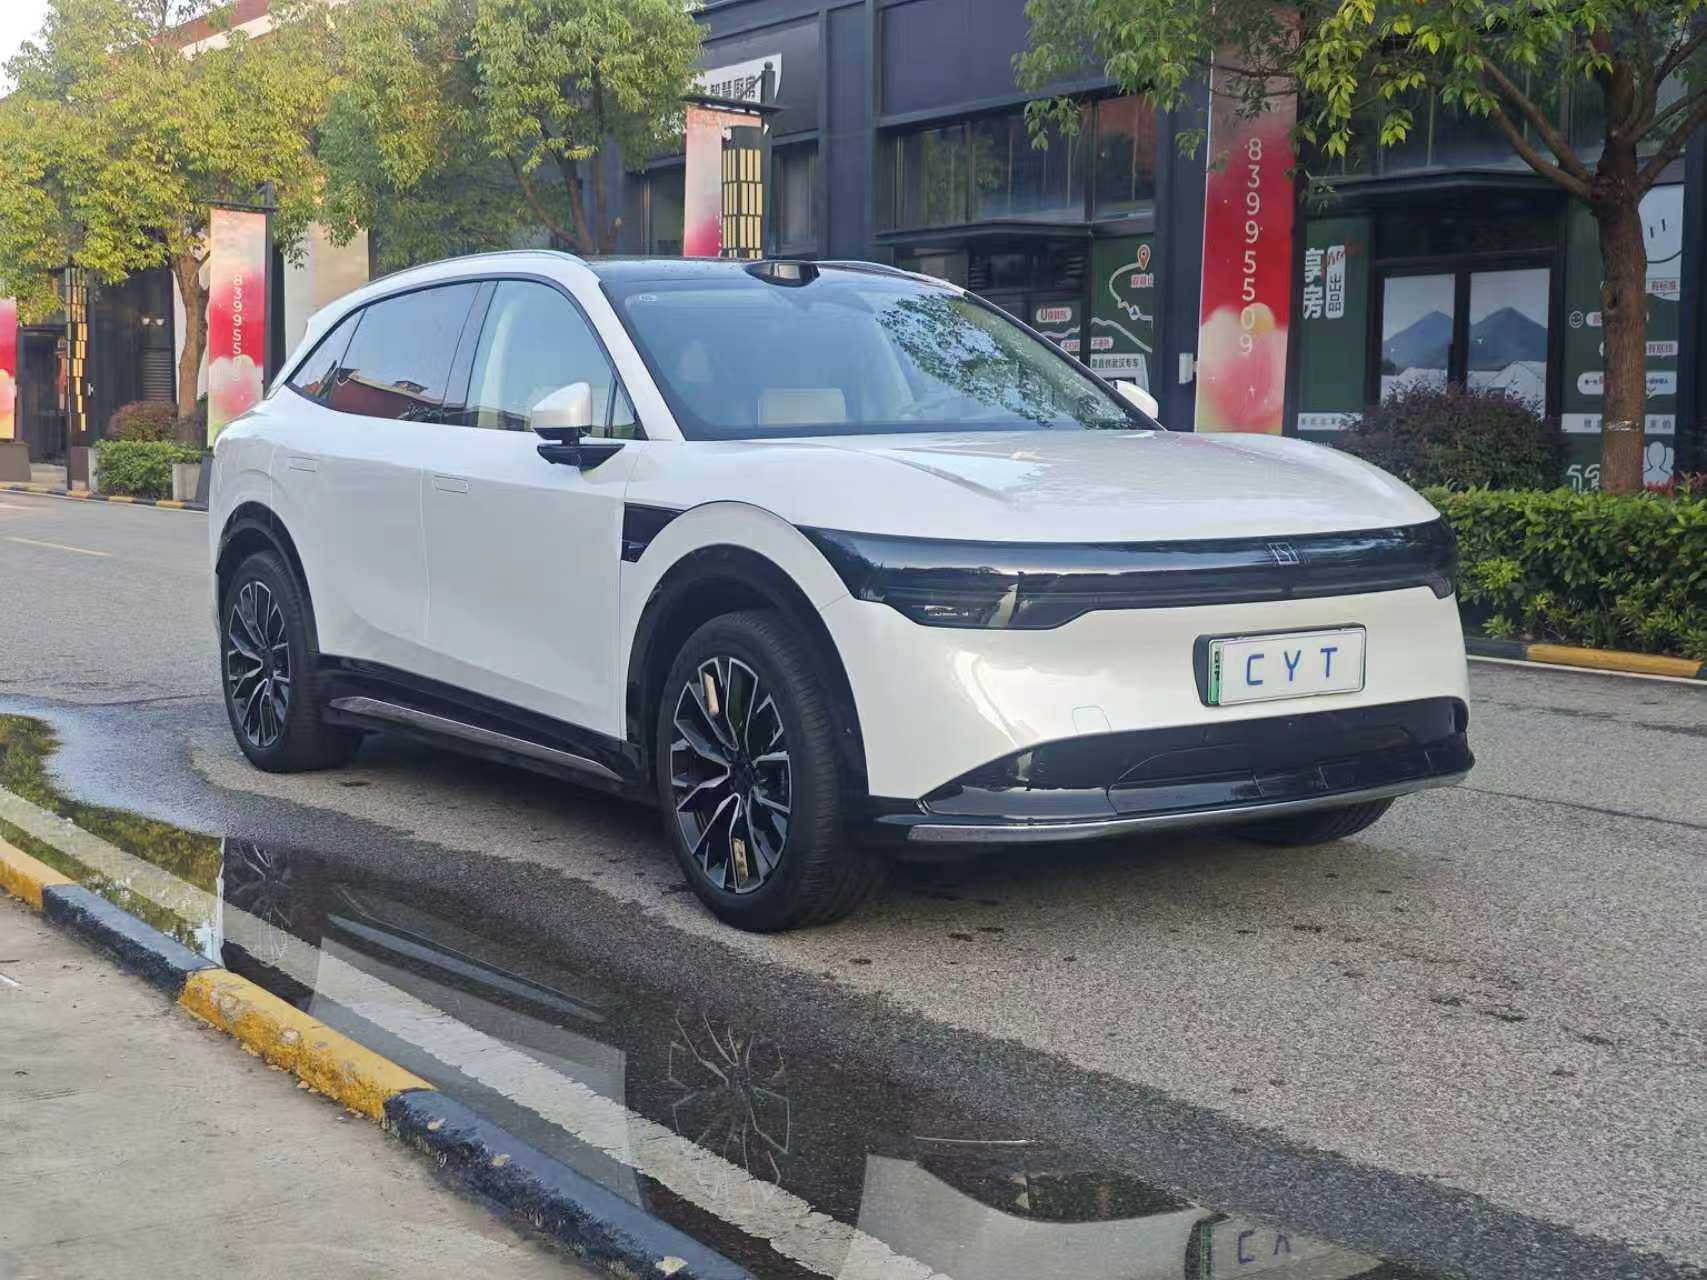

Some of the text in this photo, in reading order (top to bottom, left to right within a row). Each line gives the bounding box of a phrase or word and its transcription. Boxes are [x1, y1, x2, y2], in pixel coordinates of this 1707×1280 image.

[1240, 136, 1263, 355] 83995509
[1328, 273, 1341, 312] 出品
[1246, 647, 1338, 685] CYT
